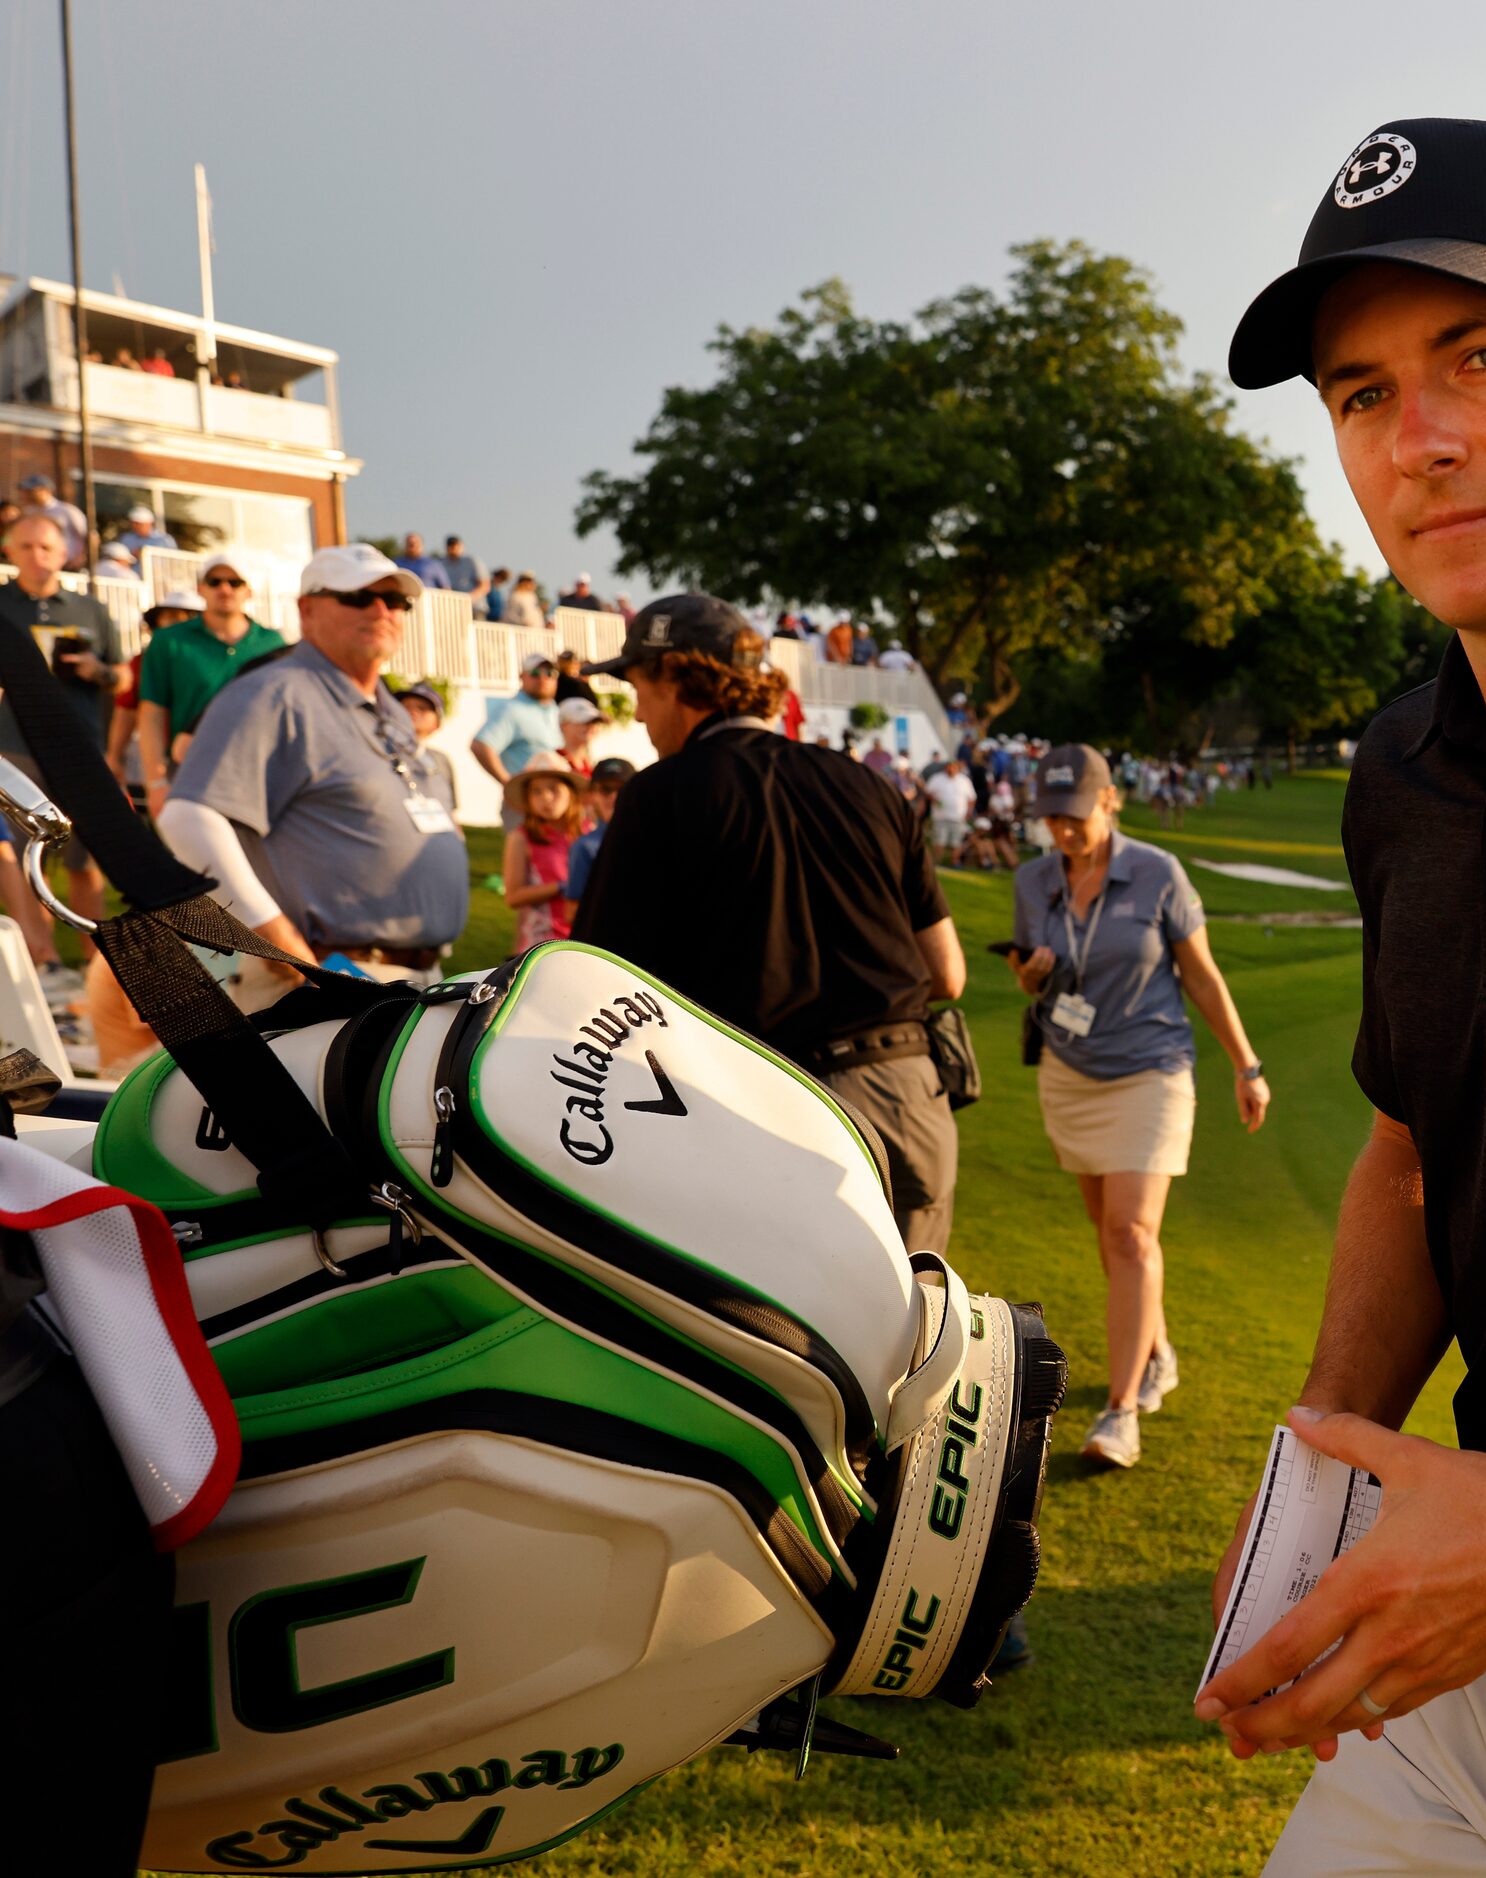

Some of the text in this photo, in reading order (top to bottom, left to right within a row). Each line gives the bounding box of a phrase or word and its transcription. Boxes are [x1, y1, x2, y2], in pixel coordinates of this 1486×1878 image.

[1336, 160, 1414, 205] ARMOUR
[550, 991, 668, 1165] Callaway
[927, 1378, 985, 1541] EPIC
[872, 1585, 941, 1691] EPIC
[206, 1743, 625, 1867] Callaway
